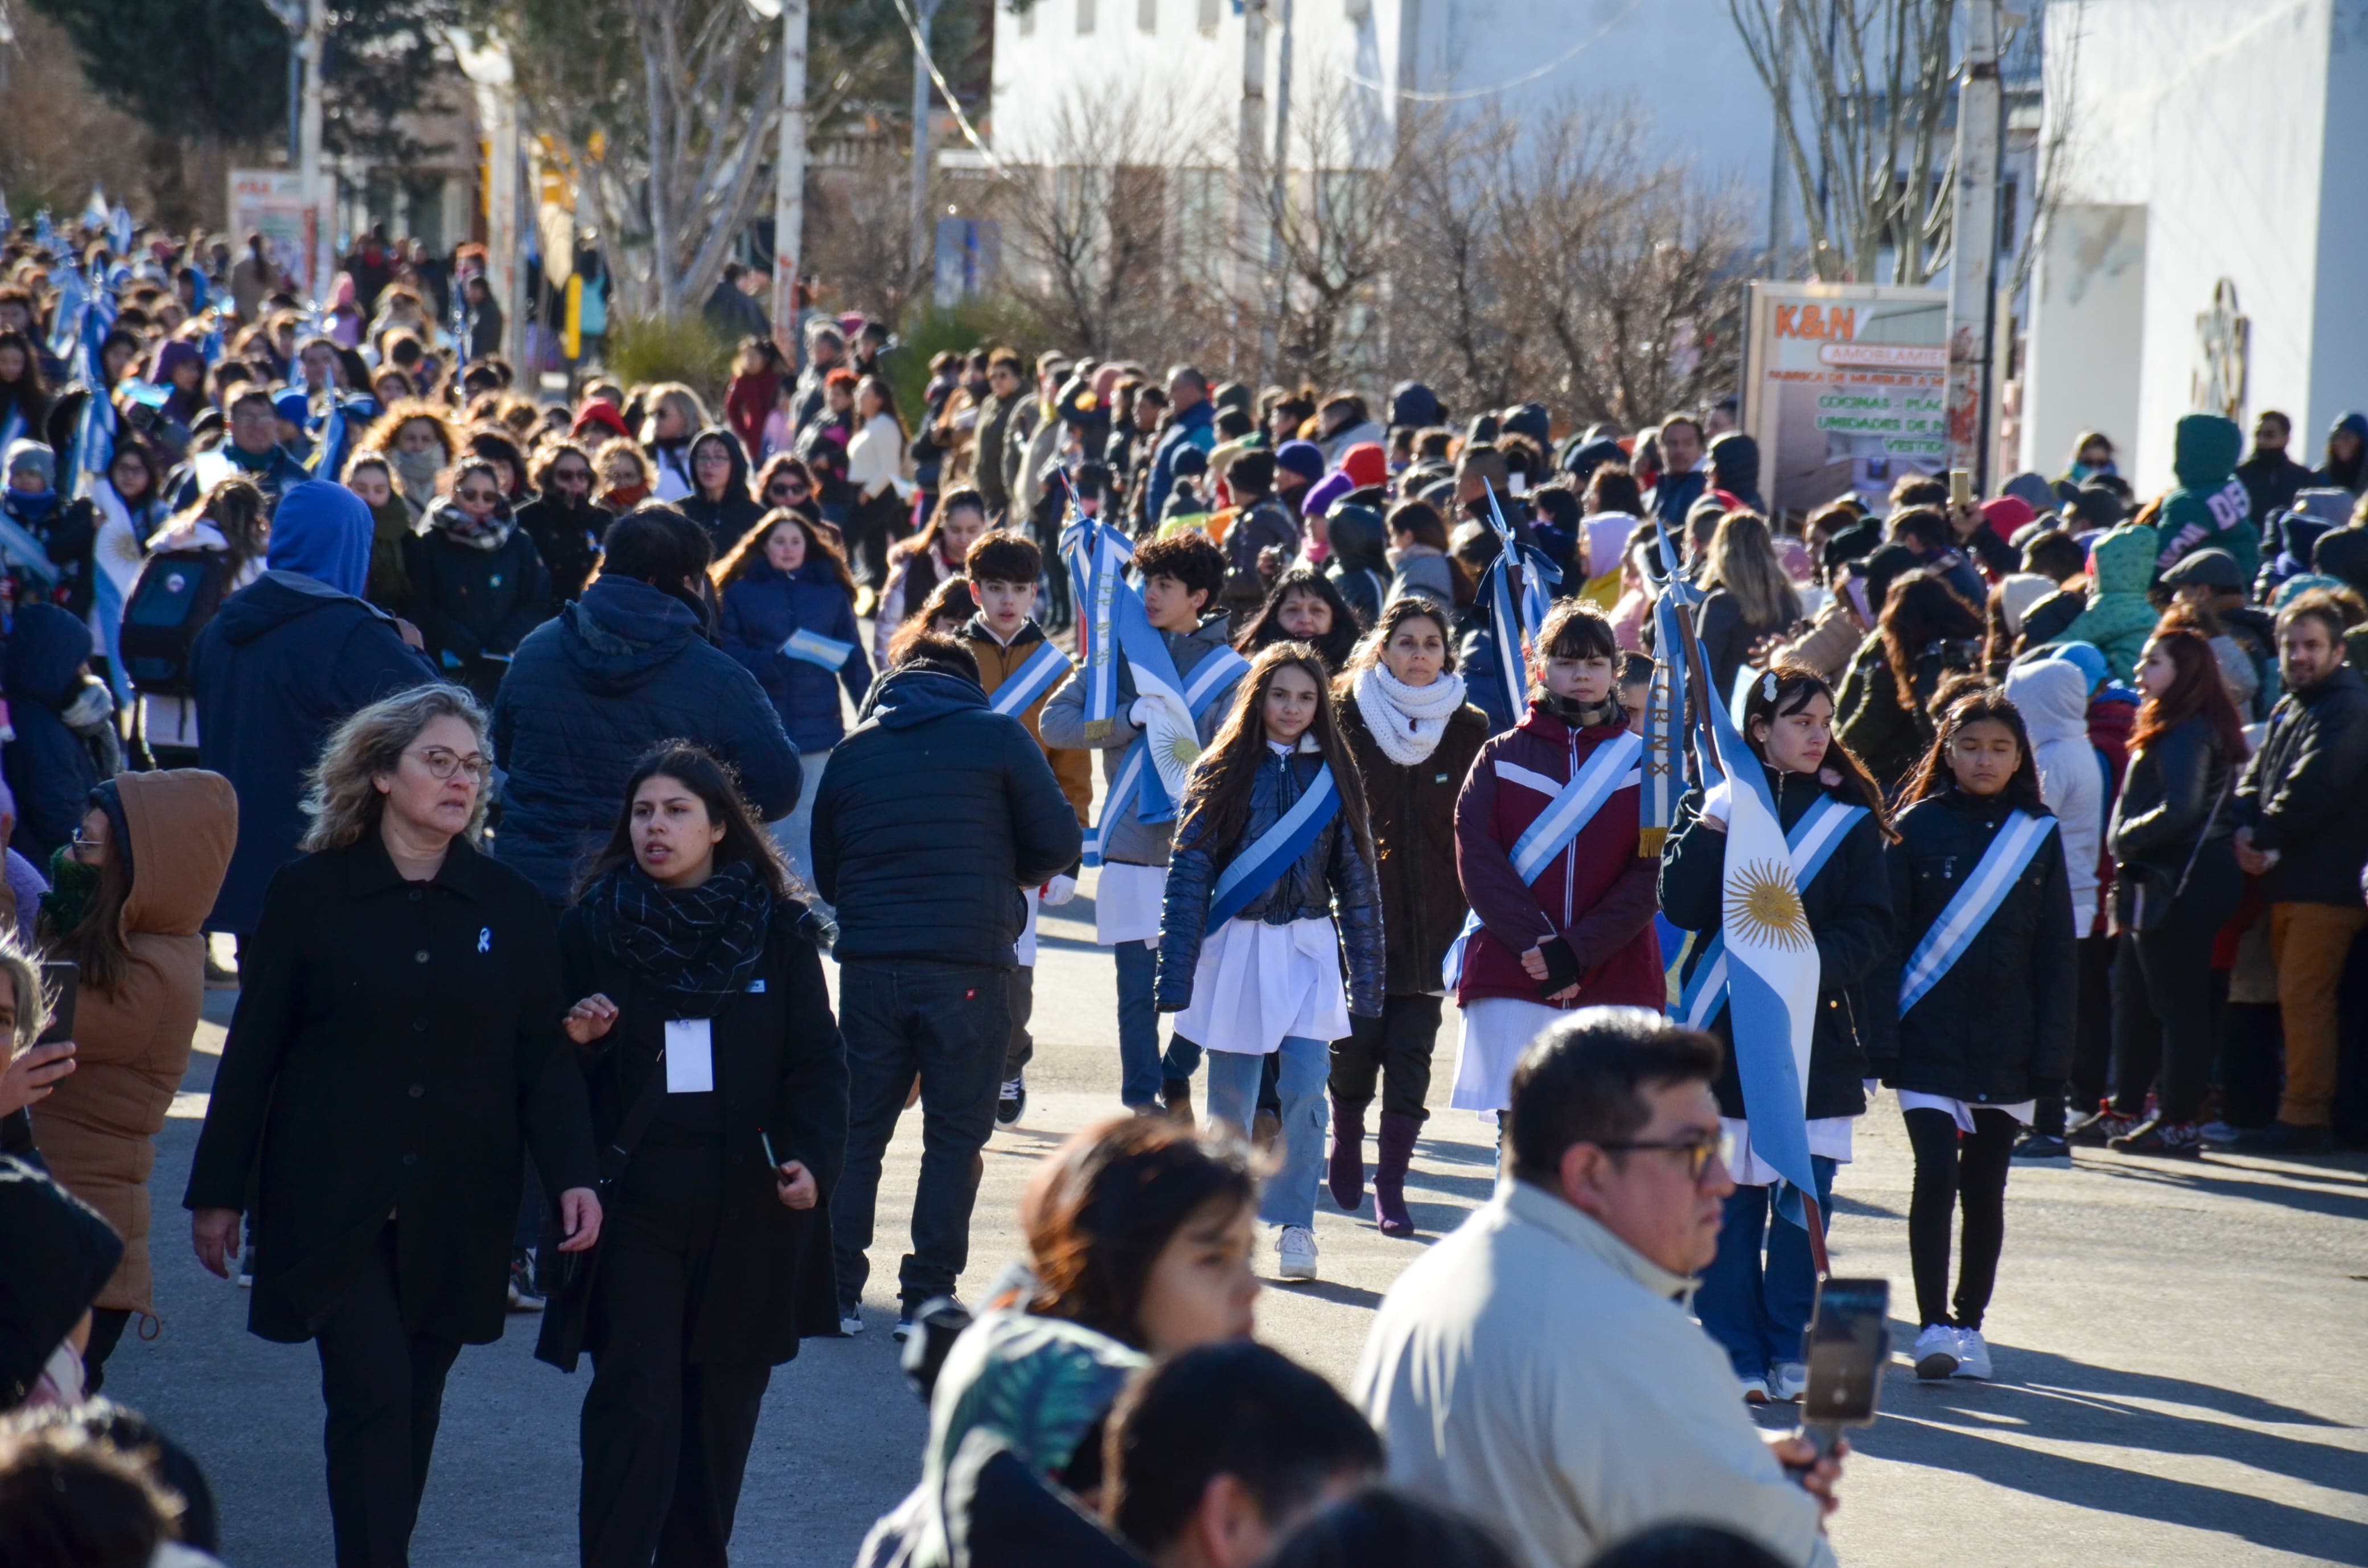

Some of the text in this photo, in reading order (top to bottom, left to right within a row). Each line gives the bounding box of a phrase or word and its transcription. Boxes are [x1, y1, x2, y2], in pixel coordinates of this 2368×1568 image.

[1774, 304, 1855, 341] K&N
[1819, 396, 1891, 409] COCINAS
[1817, 416, 1901, 430] UNIDADES
[1906, 419, 1927, 431] DE
[1646, 759, 1674, 777] 8
